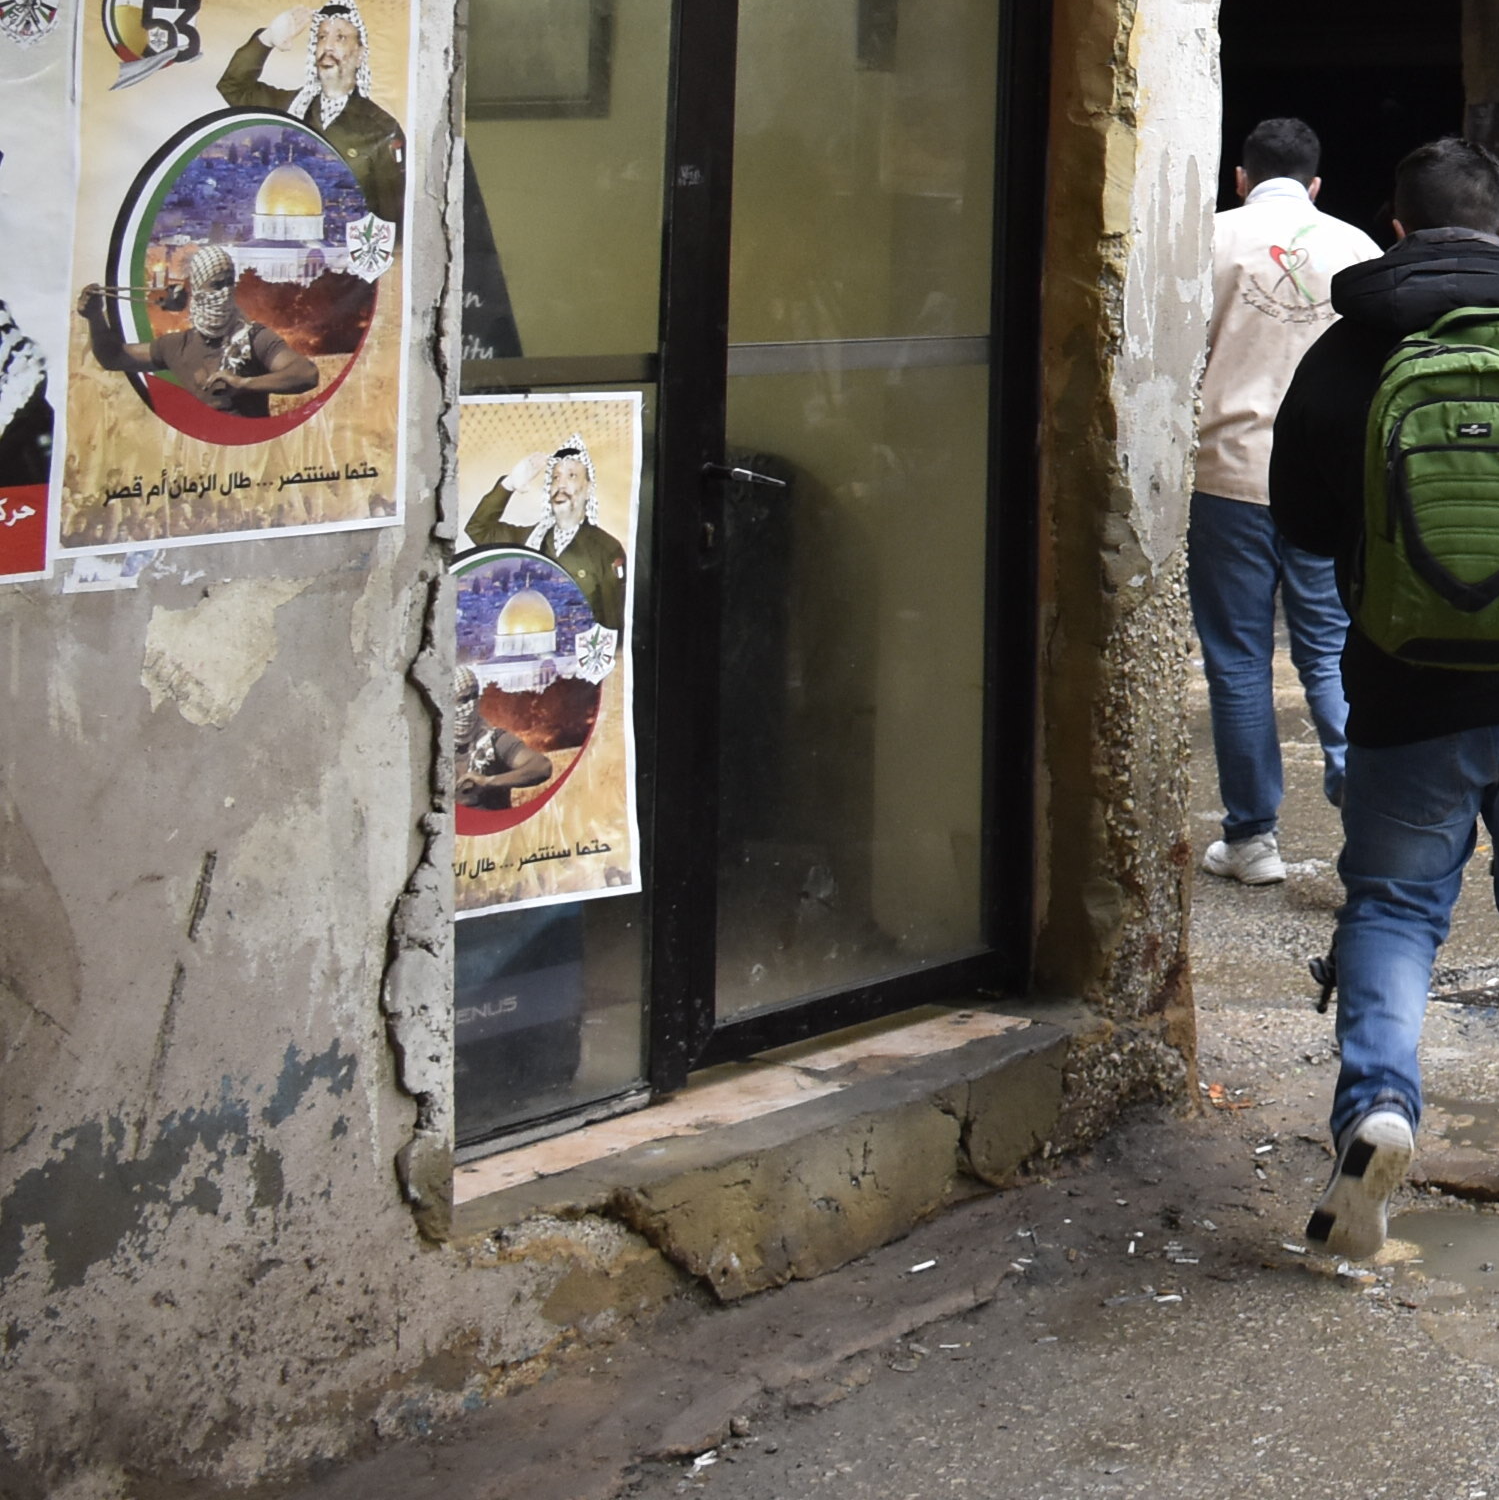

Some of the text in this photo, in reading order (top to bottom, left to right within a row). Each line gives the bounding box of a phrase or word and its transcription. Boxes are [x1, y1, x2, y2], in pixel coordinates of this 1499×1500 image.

[220, 472, 250, 496] طال
[278, 466, 340, 492] سننتصر
[345, 462, 378, 480] حتما
[103, 476, 143, 507] قصر
[146, 469, 166, 505] أم
[170, 474, 216, 499] الزمان
[0, 497, 36, 527] حر
[517, 846, 571, 872] سننتصر
[576, 839, 612, 856] حتما
[469, 858, 496, 879] طال
[455, 996, 518, 1025] ENUS
